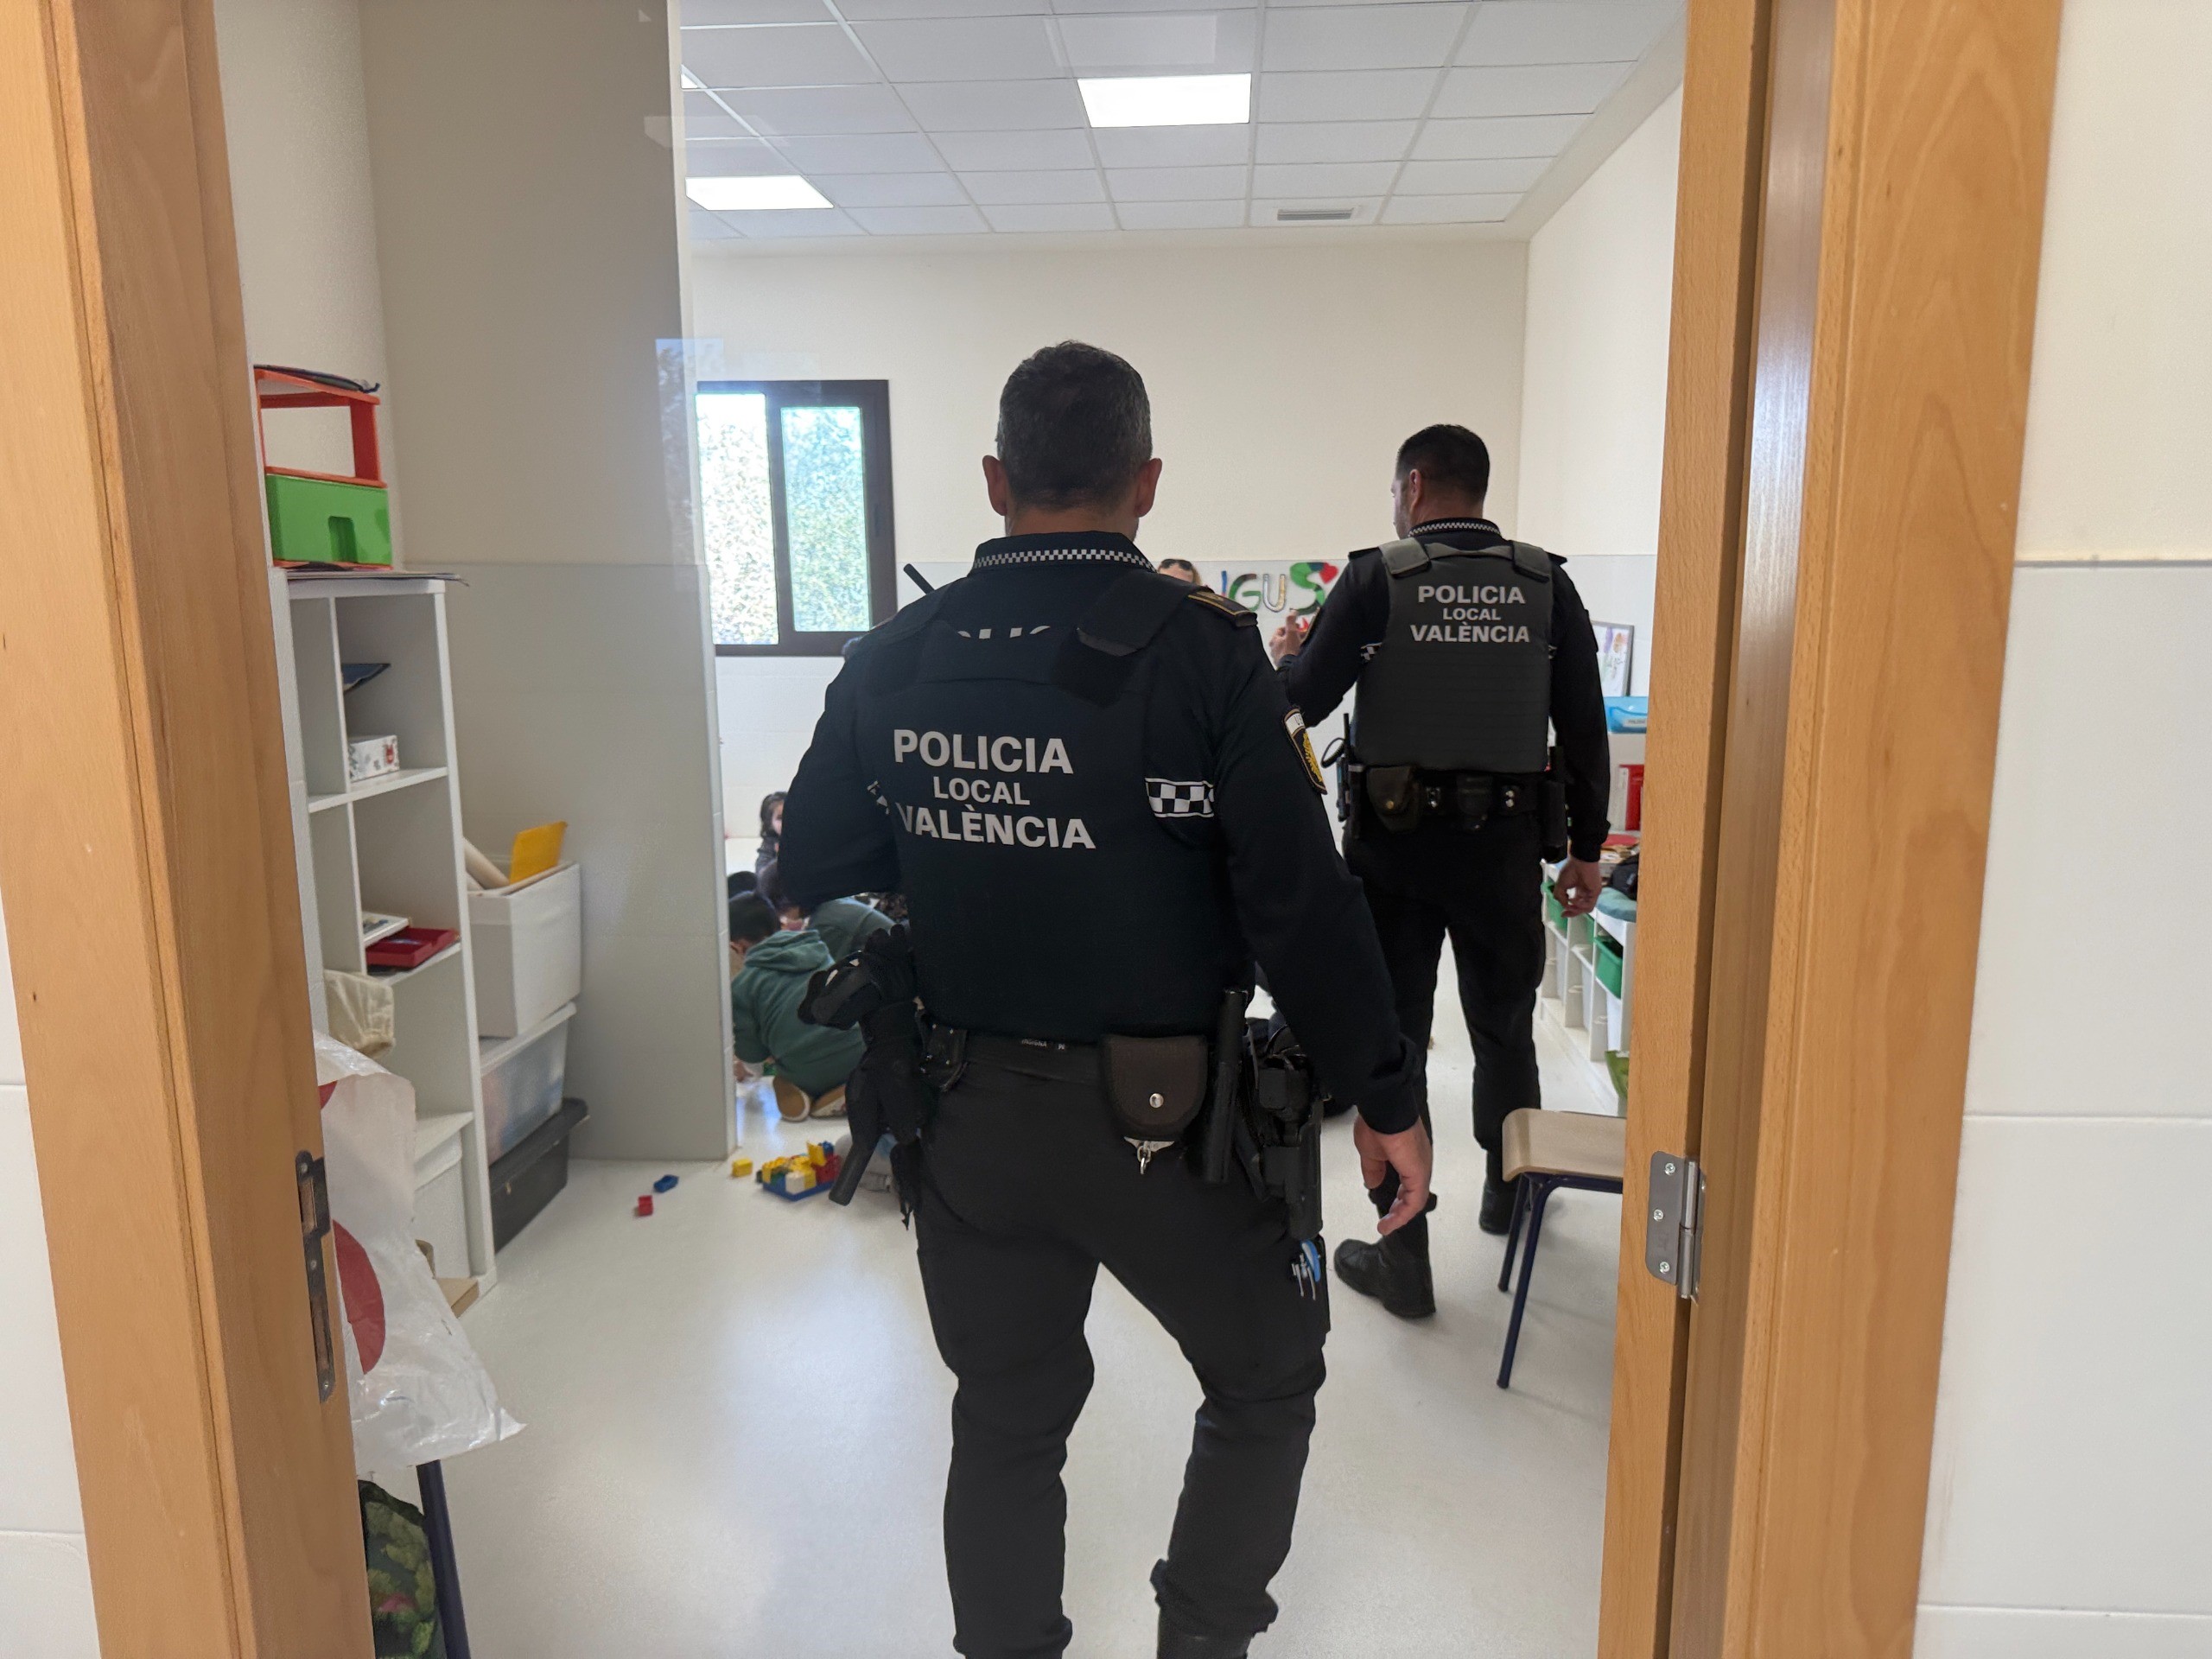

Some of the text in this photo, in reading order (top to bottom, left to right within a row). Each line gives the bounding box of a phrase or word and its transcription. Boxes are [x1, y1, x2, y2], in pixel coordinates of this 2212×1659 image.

[1418, 585, 1526, 604] POLICIA
[1442, 607, 1502, 620] LOCAL
[1409, 621, 1530, 643] VALÈNCIA
[893, 728, 1074, 775] POLICIA
[933, 776, 1031, 805] LOCAL
[895, 802, 1097, 850] VALÈNCIA
